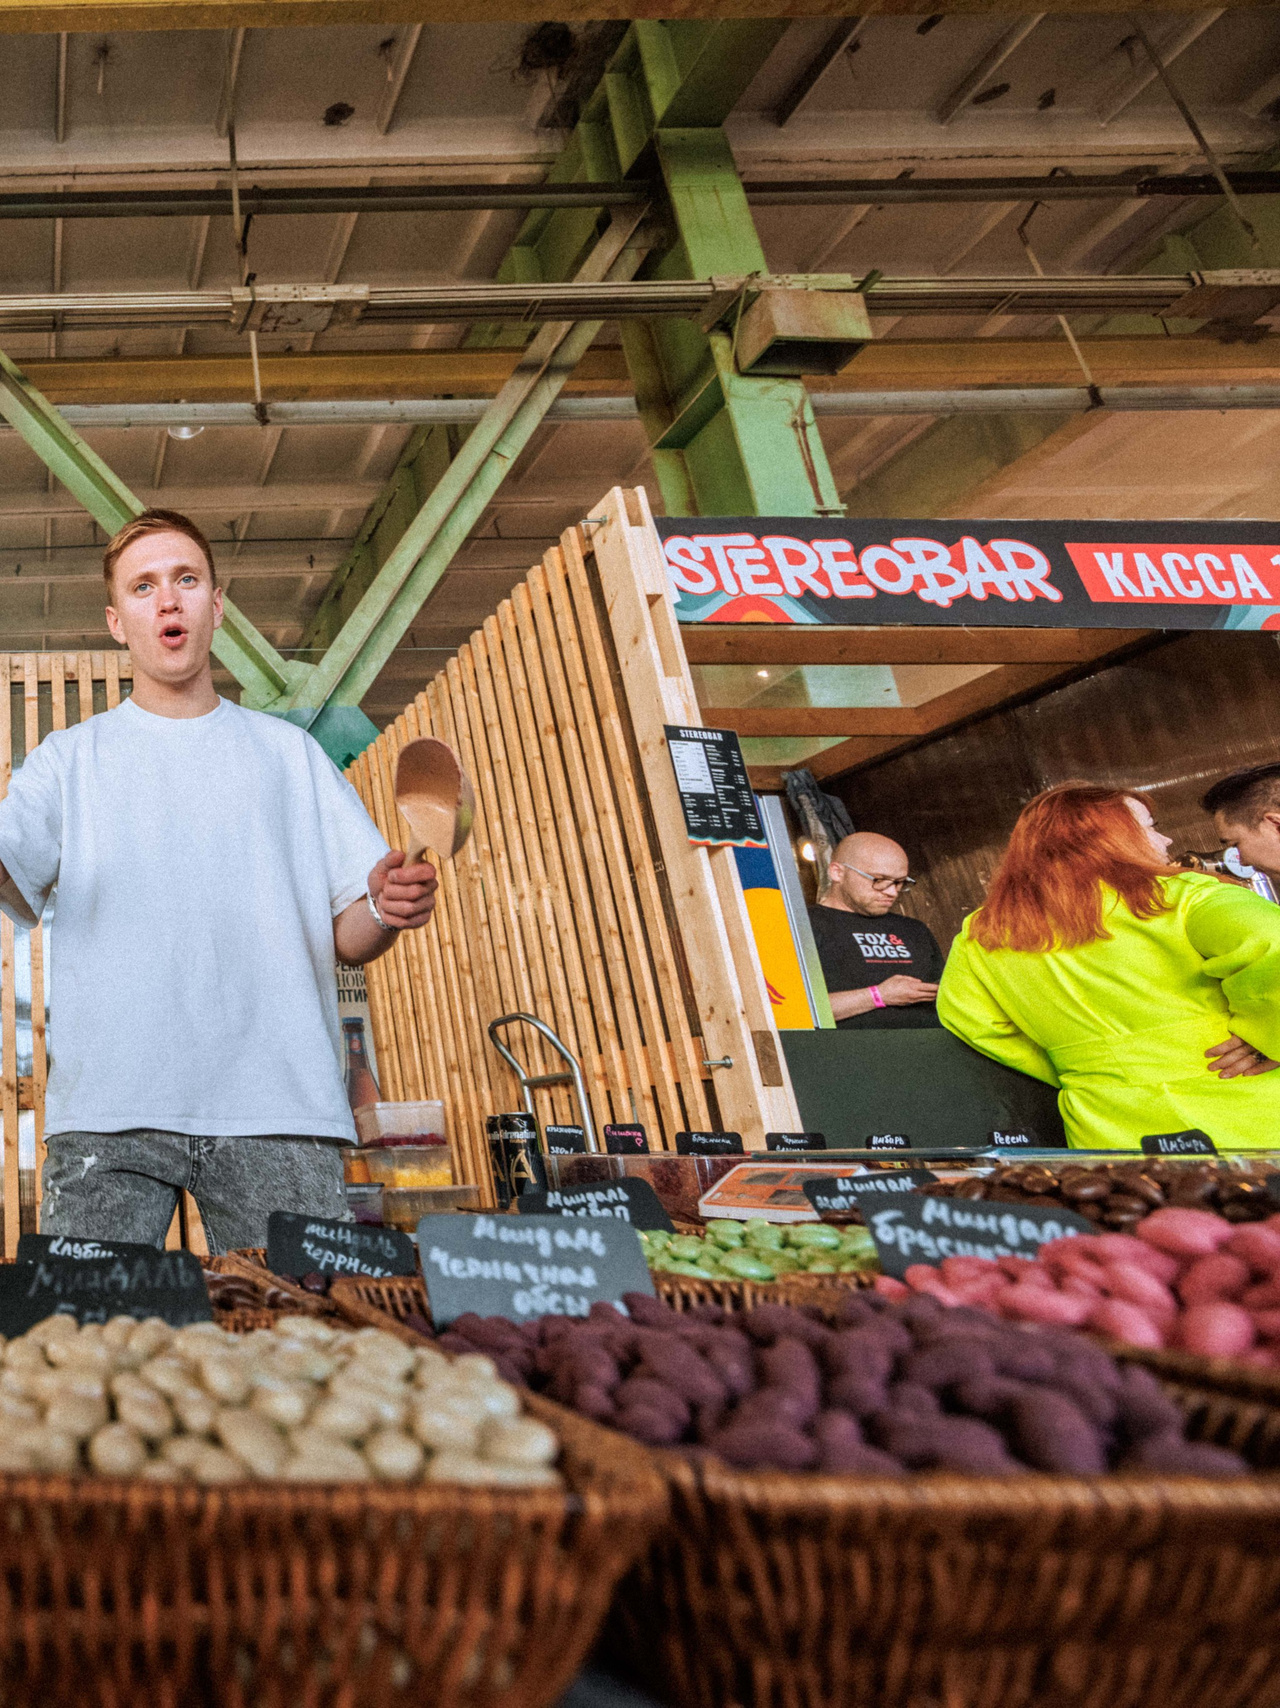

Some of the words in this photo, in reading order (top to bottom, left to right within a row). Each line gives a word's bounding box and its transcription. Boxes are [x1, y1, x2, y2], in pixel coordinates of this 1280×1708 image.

[663, 532, 1063, 607] STEREOBAR
[1093, 552, 1273, 600] КАССА
[679, 729, 724, 742] STEREOBAR
[859, 945, 912, 958] DOGS
